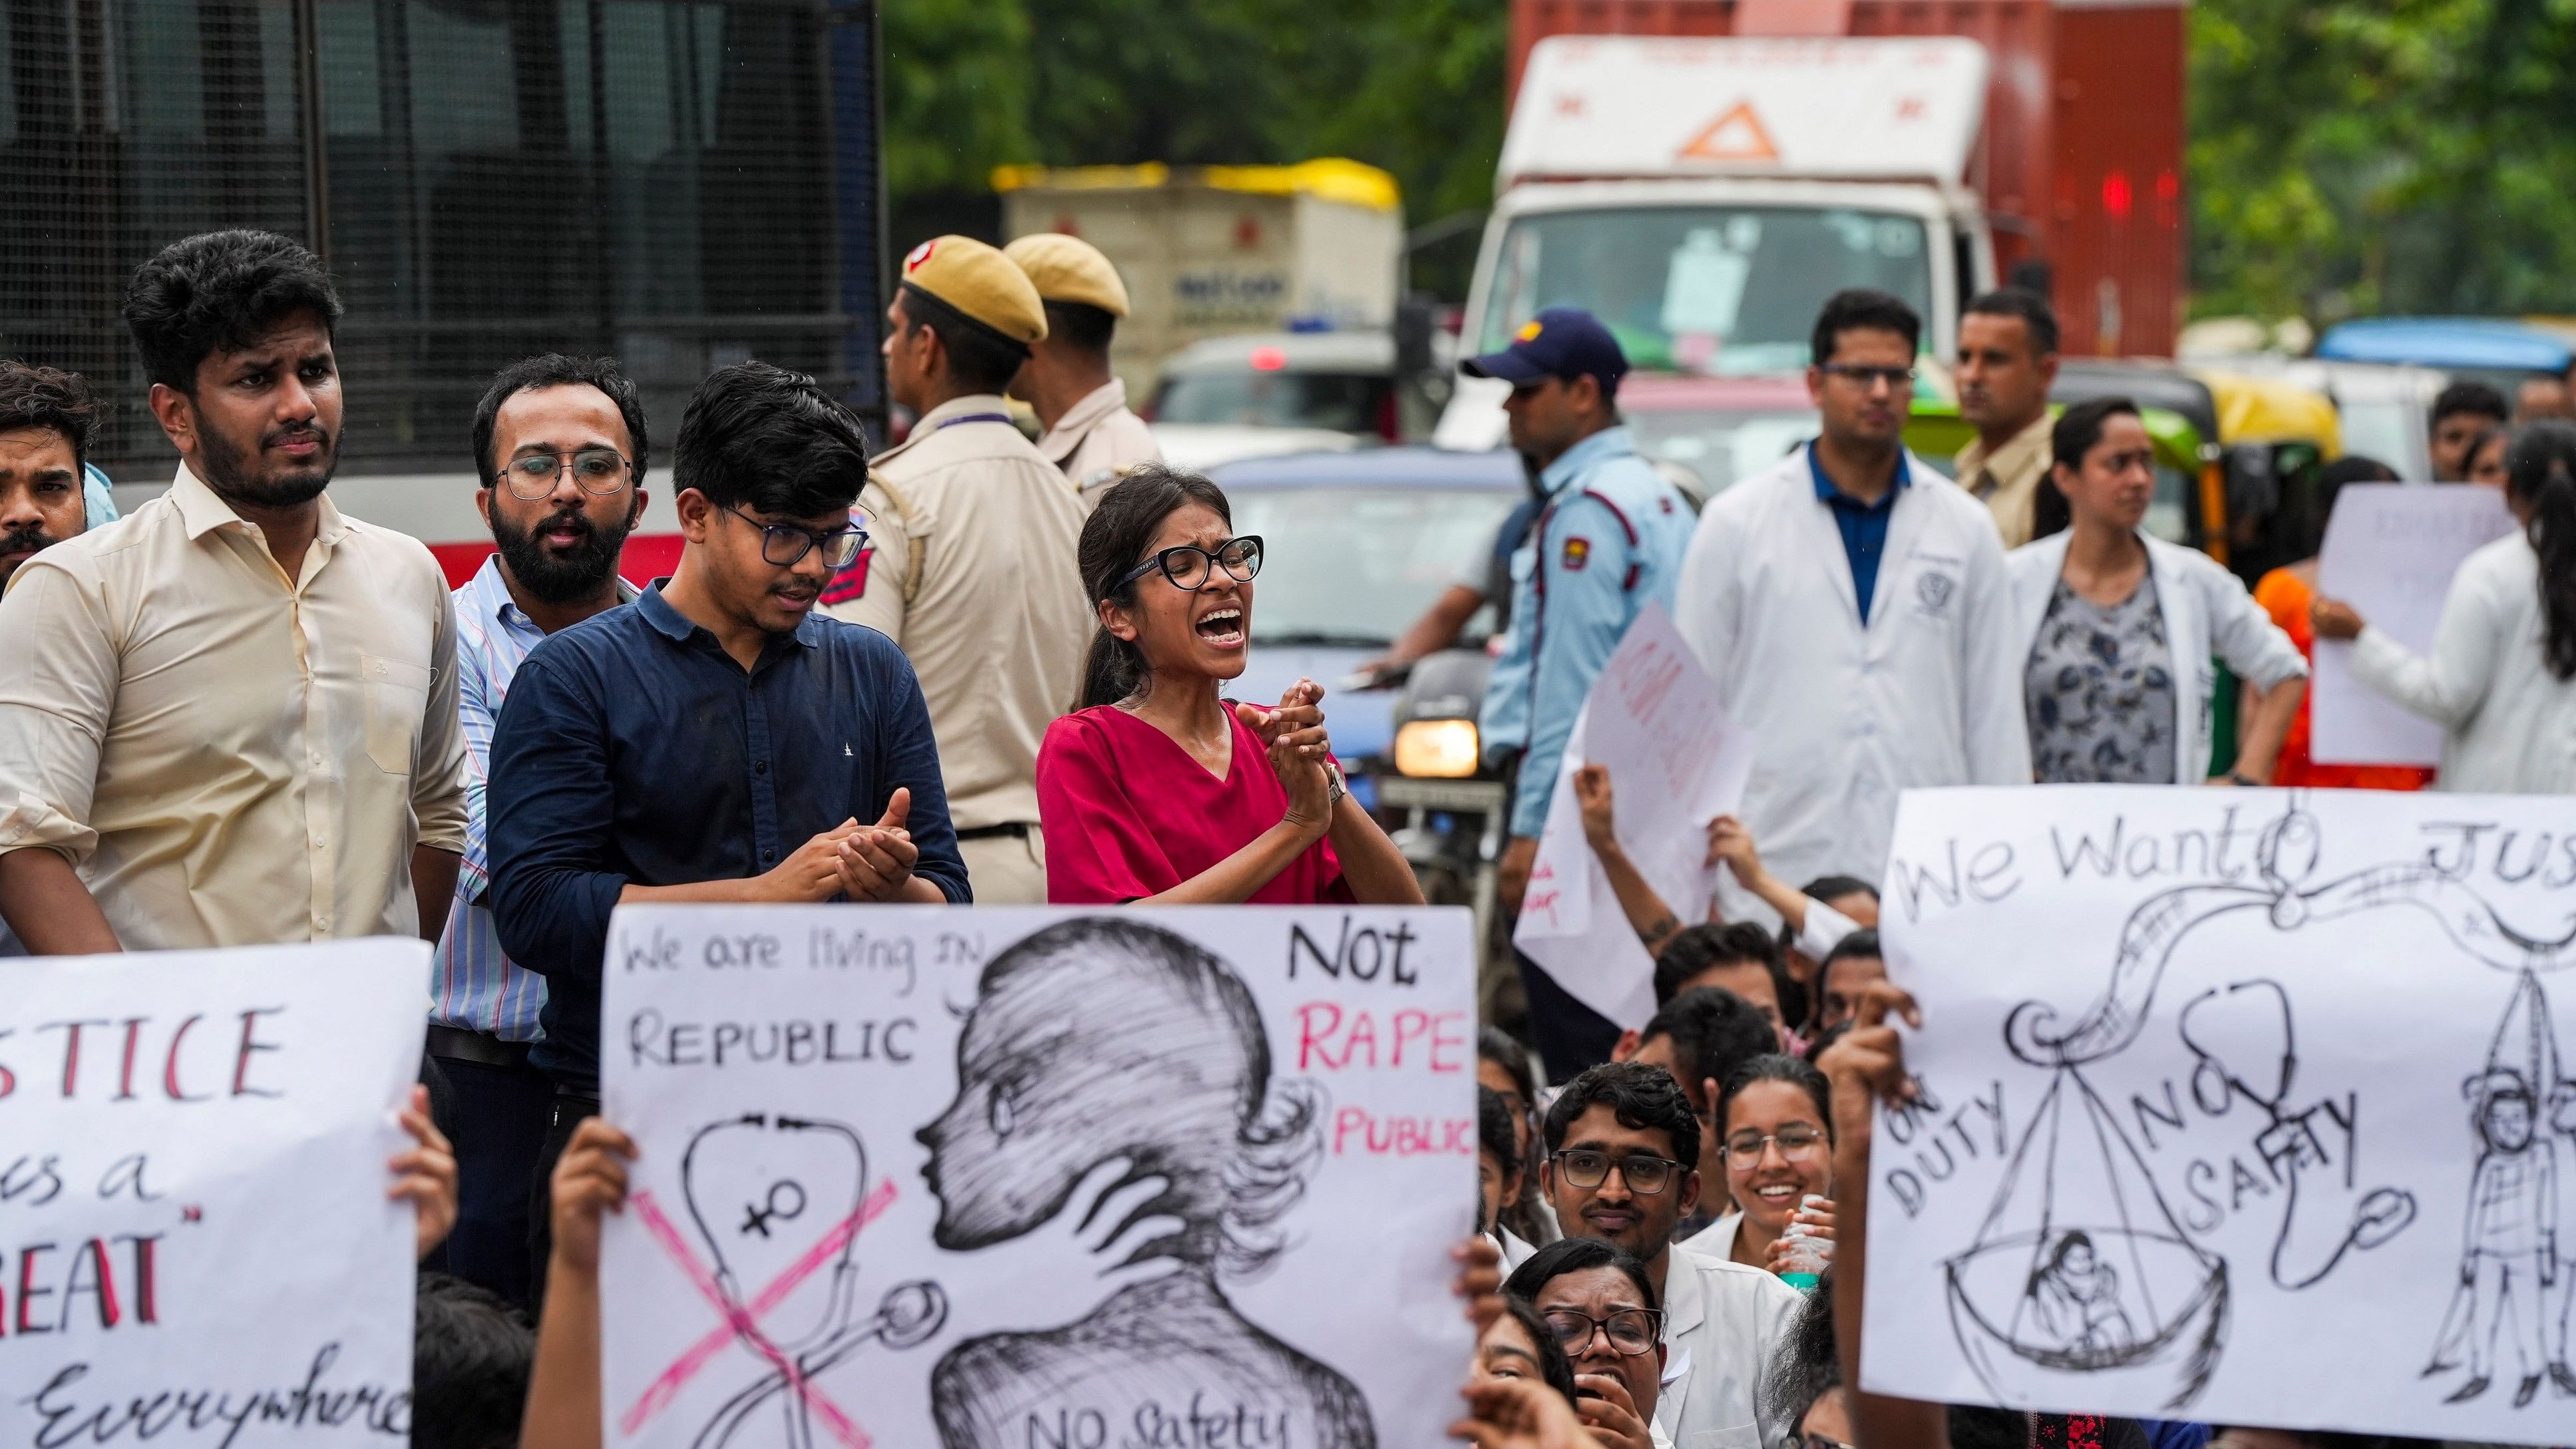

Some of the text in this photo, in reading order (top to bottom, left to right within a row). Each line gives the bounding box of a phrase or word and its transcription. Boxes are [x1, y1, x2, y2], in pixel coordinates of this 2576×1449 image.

[1895, 804, 2576, 925] We Want JUS
[618, 927, 986, 997] We are living IN
[1289, 915, 1419, 986] Not
[629, 1007, 918, 1068] REPUBLIC
[1296, 1001, 1467, 1072] RAPE
[1335, 1108, 1474, 1155] PUBLIC
[2131, 1058, 2231, 1149] NO
[98, 1153, 166, 1201] a
[1887, 1078, 2007, 1219] DUTY
[0, 1205, 204, 1339] EAT"
[1027, 1388, 1291, 1449] NO Safety
